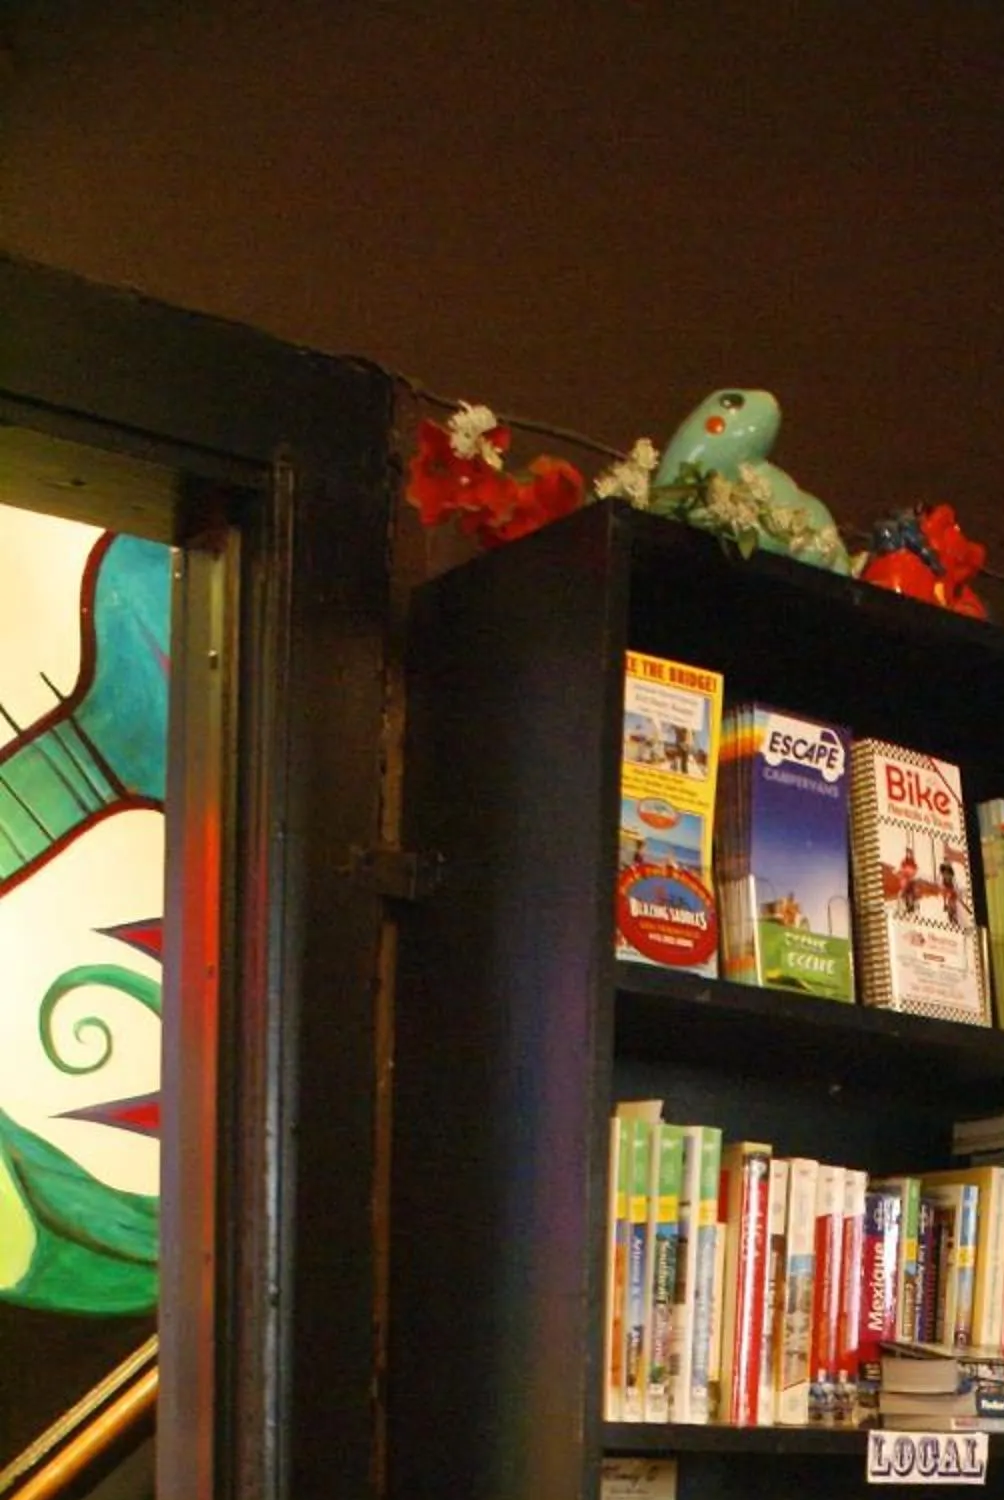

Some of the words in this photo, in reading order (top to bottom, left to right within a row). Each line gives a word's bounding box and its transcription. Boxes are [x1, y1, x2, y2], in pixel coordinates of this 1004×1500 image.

[643, 659, 665, 680] THE
[668, 665, 718, 694] BRIDGE!
[769, 730, 841, 771] ESCAPE
[884, 763, 952, 815] Bike
[868, 1241, 889, 1332] Mexique
[870, 1436, 984, 1477] LOCAL
